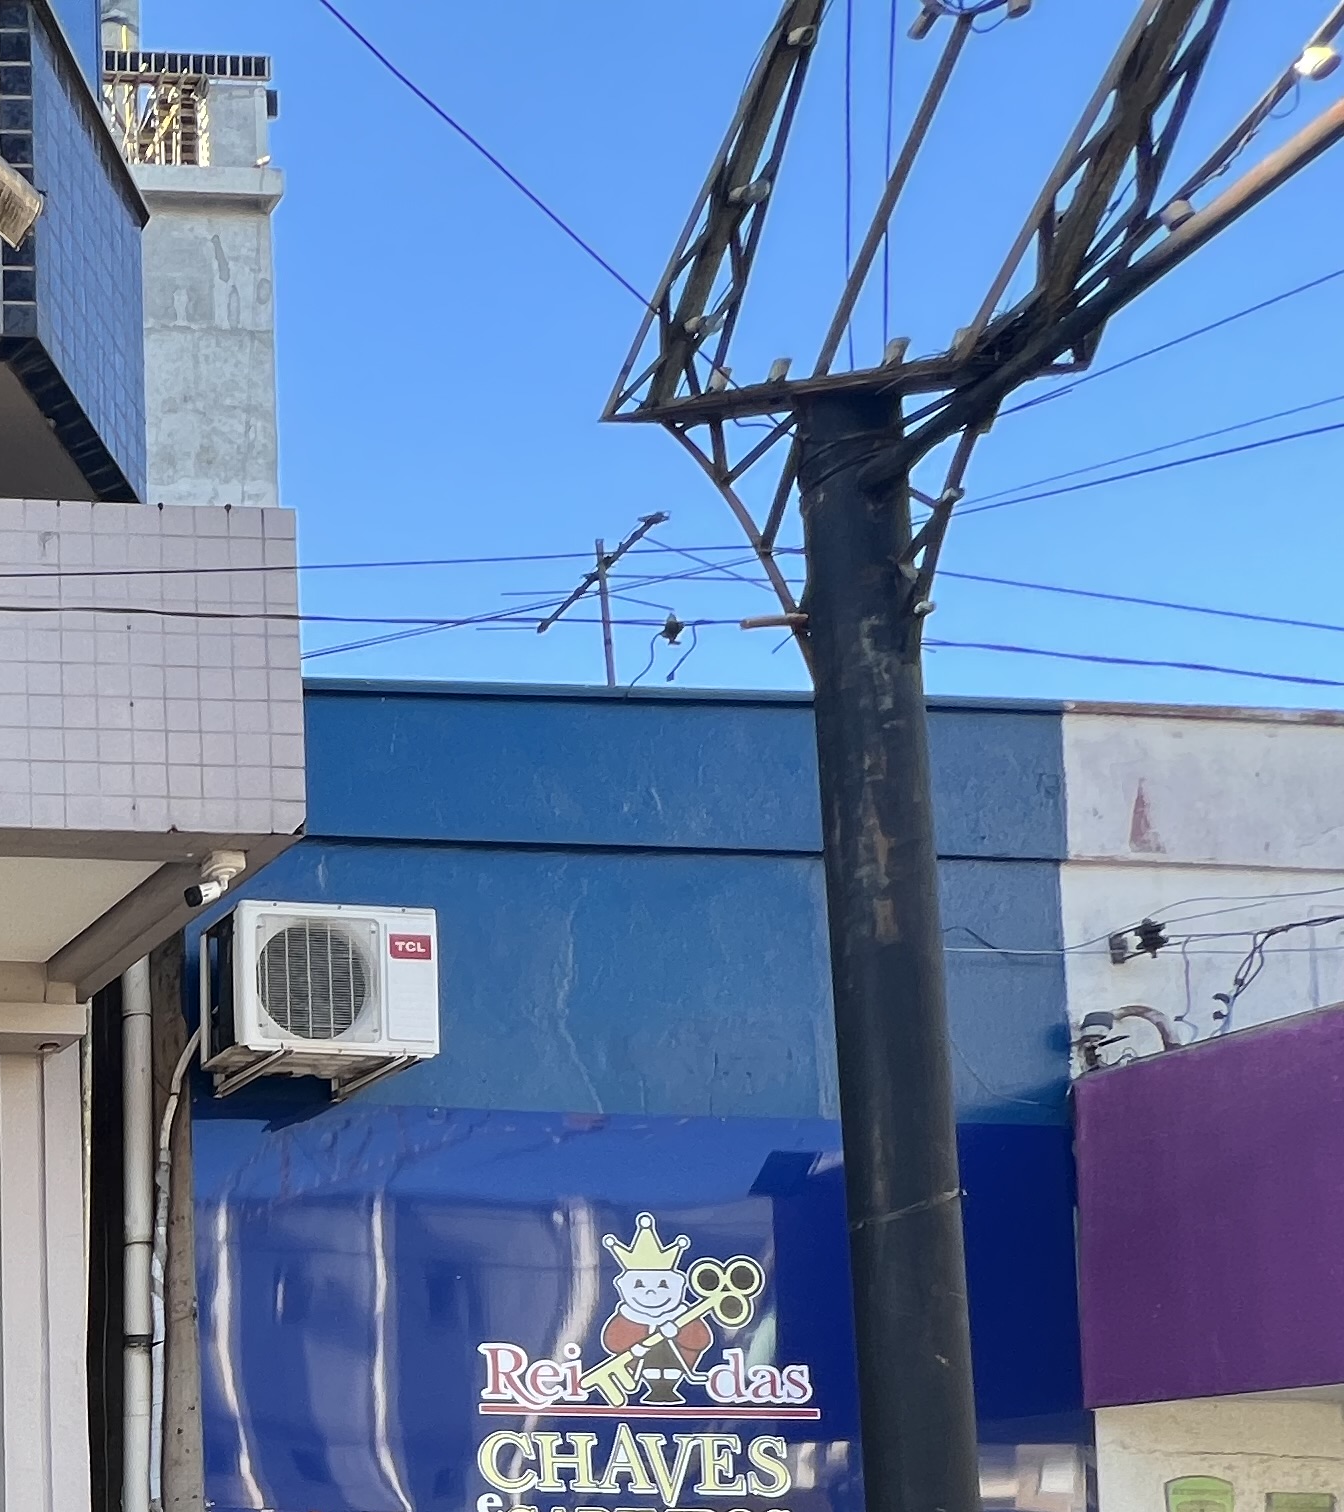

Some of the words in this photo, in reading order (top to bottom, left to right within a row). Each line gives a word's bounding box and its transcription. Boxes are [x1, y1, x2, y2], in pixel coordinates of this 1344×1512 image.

[394, 940, 427, 954] TCL
[477, 1342, 589, 1408] Rei
[705, 1348, 813, 1405] das
[477, 1423, 793, 1508] CHAVES
